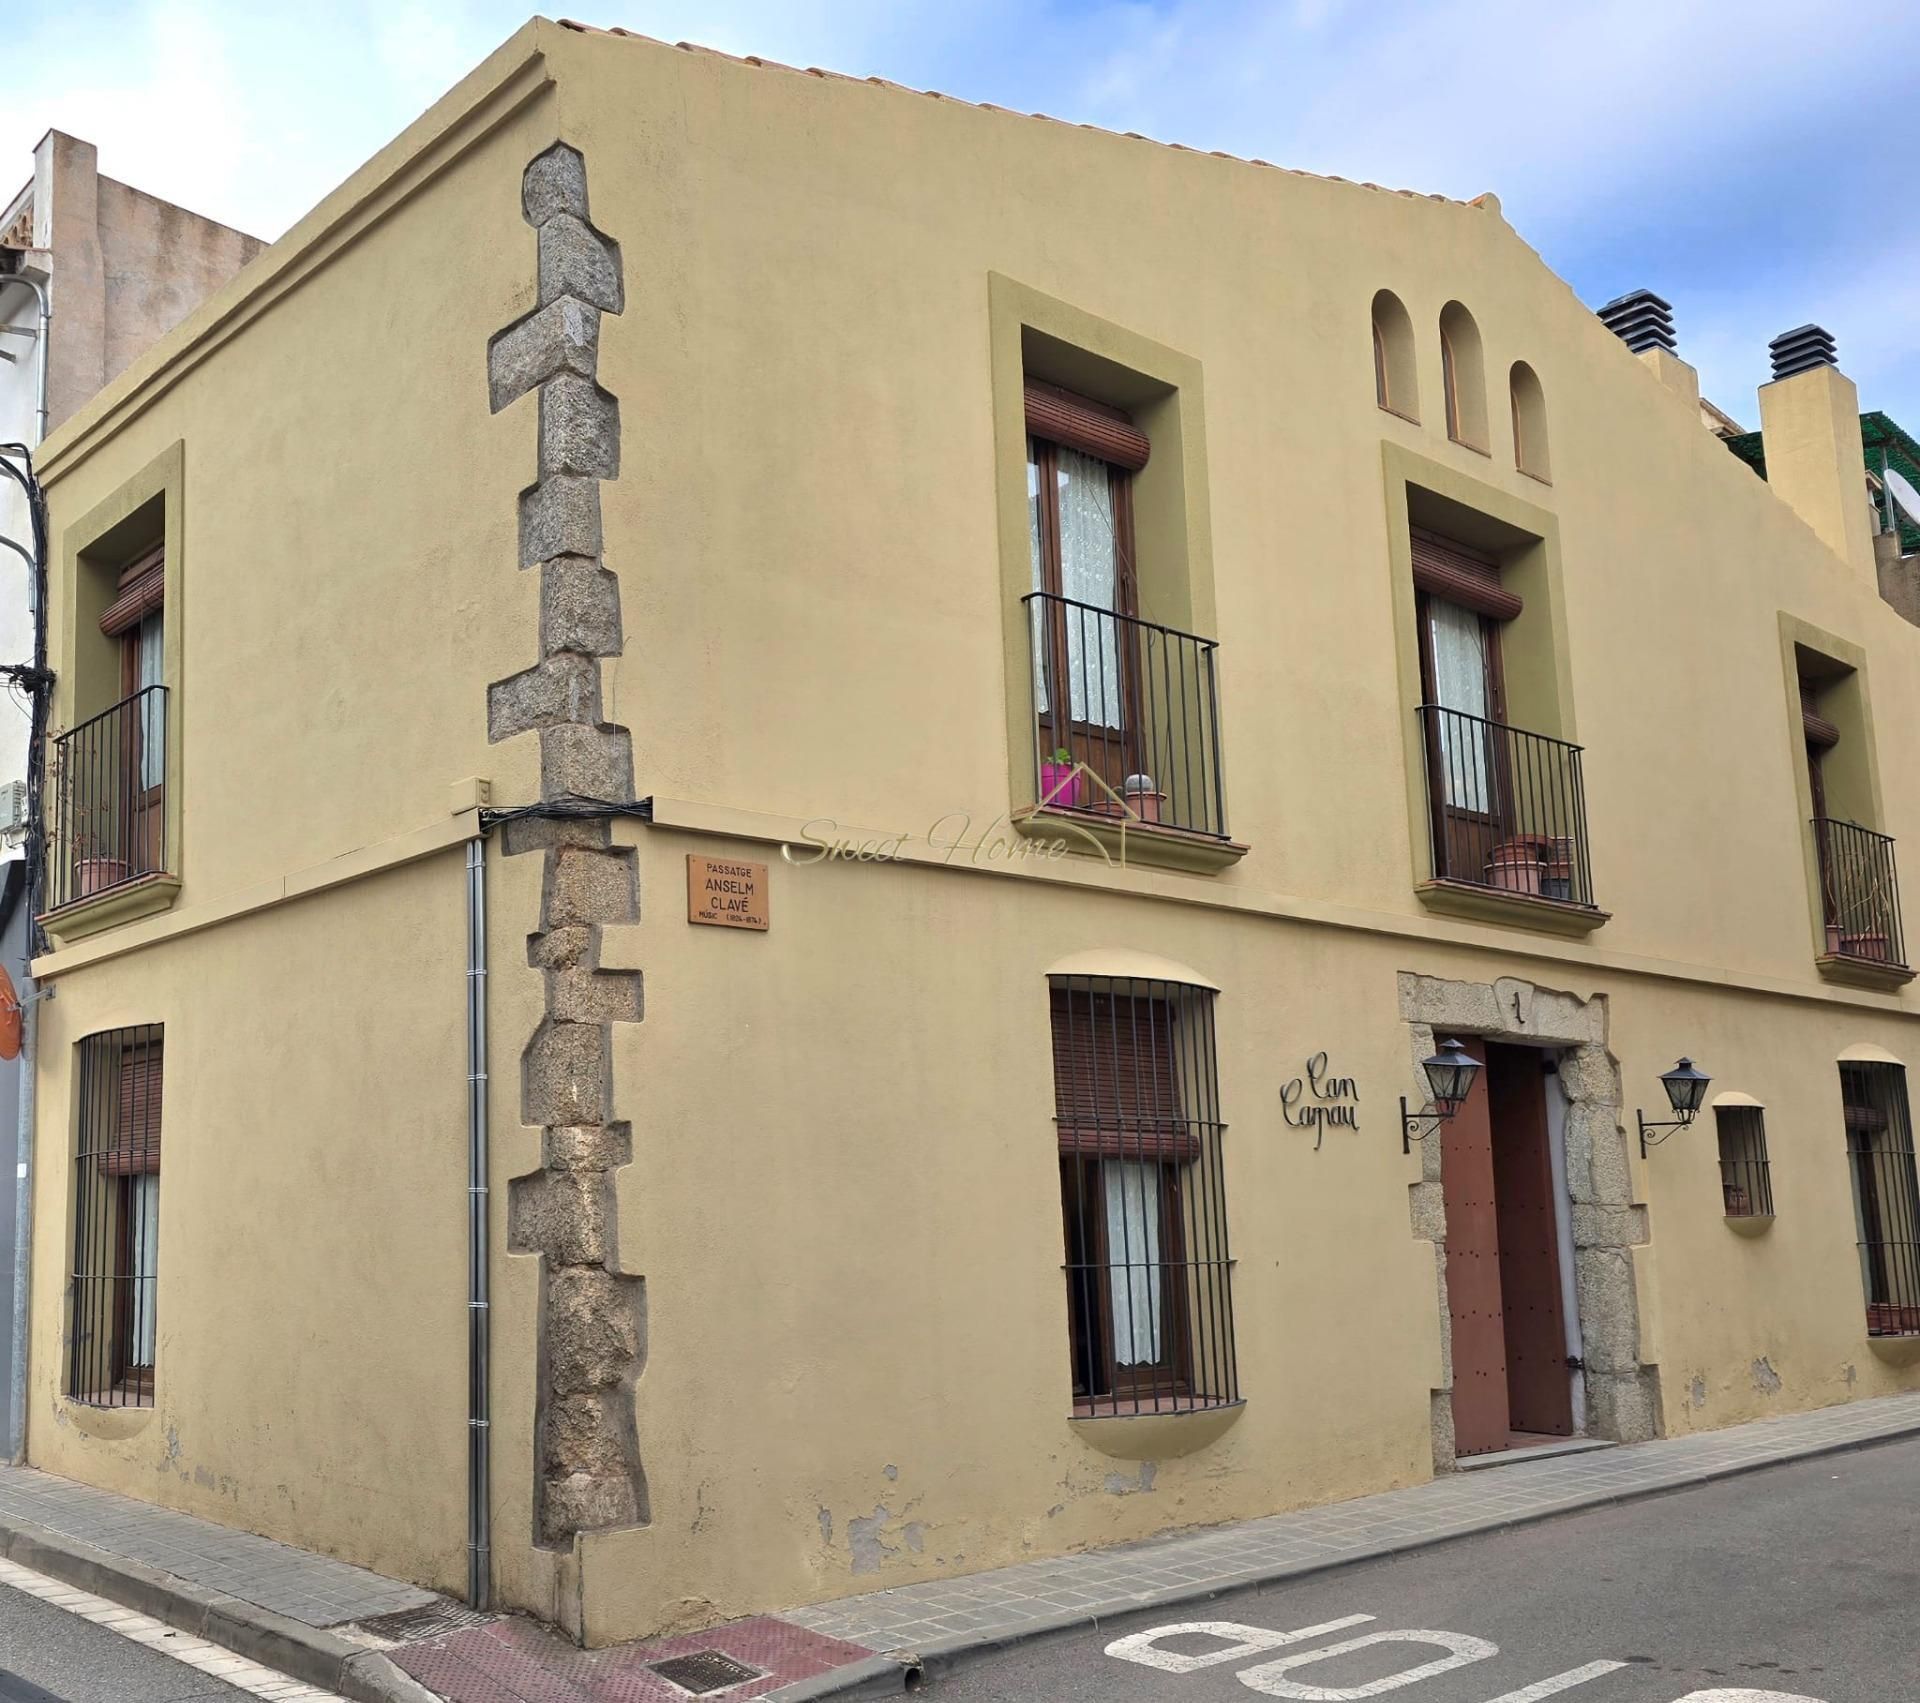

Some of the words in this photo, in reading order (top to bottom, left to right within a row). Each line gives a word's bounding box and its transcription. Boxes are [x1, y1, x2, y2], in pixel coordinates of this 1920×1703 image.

[706, 863, 752, 878] PASSATGE
[705, 878, 754, 896] ANSELM
[710, 896, 749, 913] CLAVÉ
[1306, 1051, 1360, 1102] Can
